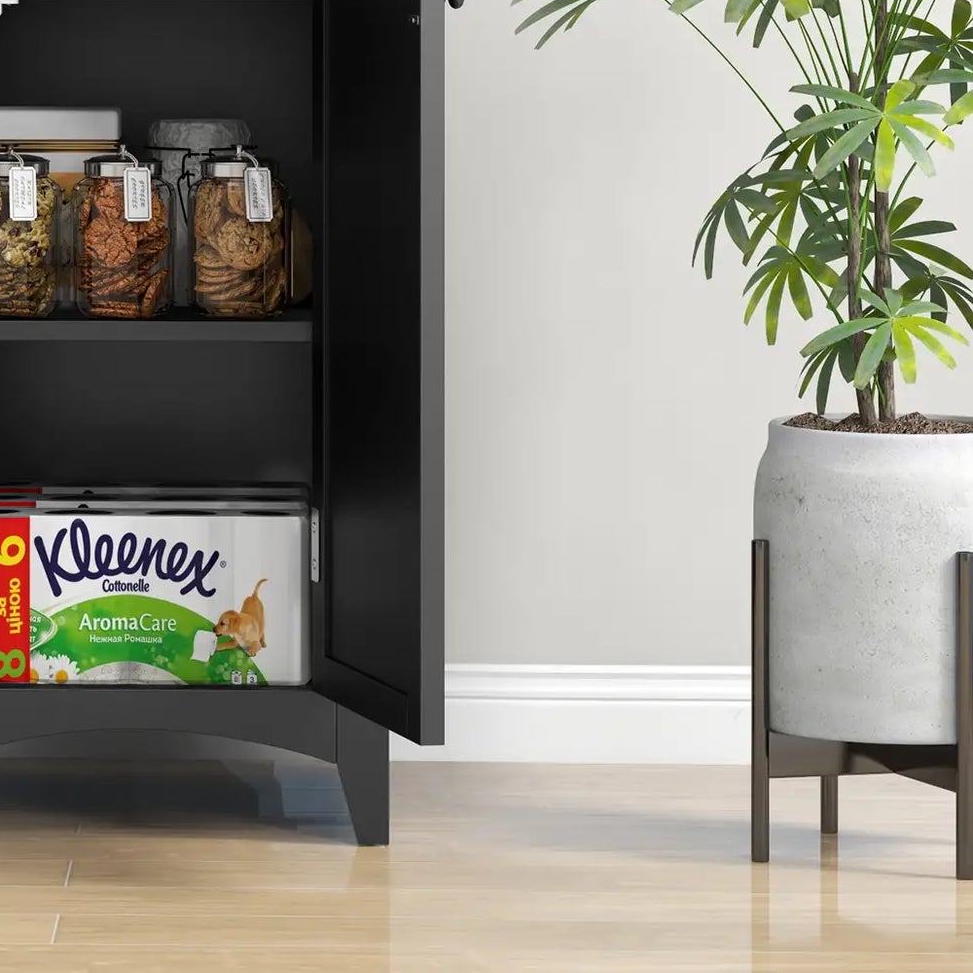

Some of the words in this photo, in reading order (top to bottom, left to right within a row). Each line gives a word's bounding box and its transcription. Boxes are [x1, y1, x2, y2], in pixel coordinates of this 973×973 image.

[34, 518, 219, 597] Kleenex
[102, 579, 150, 593] Cottonelle
[6, 577, 23, 634] ціною
[79, 613, 176, 631] AromaCare
[89, 634, 122, 644] Нежная
[124, 634, 163, 644] Ромашка
